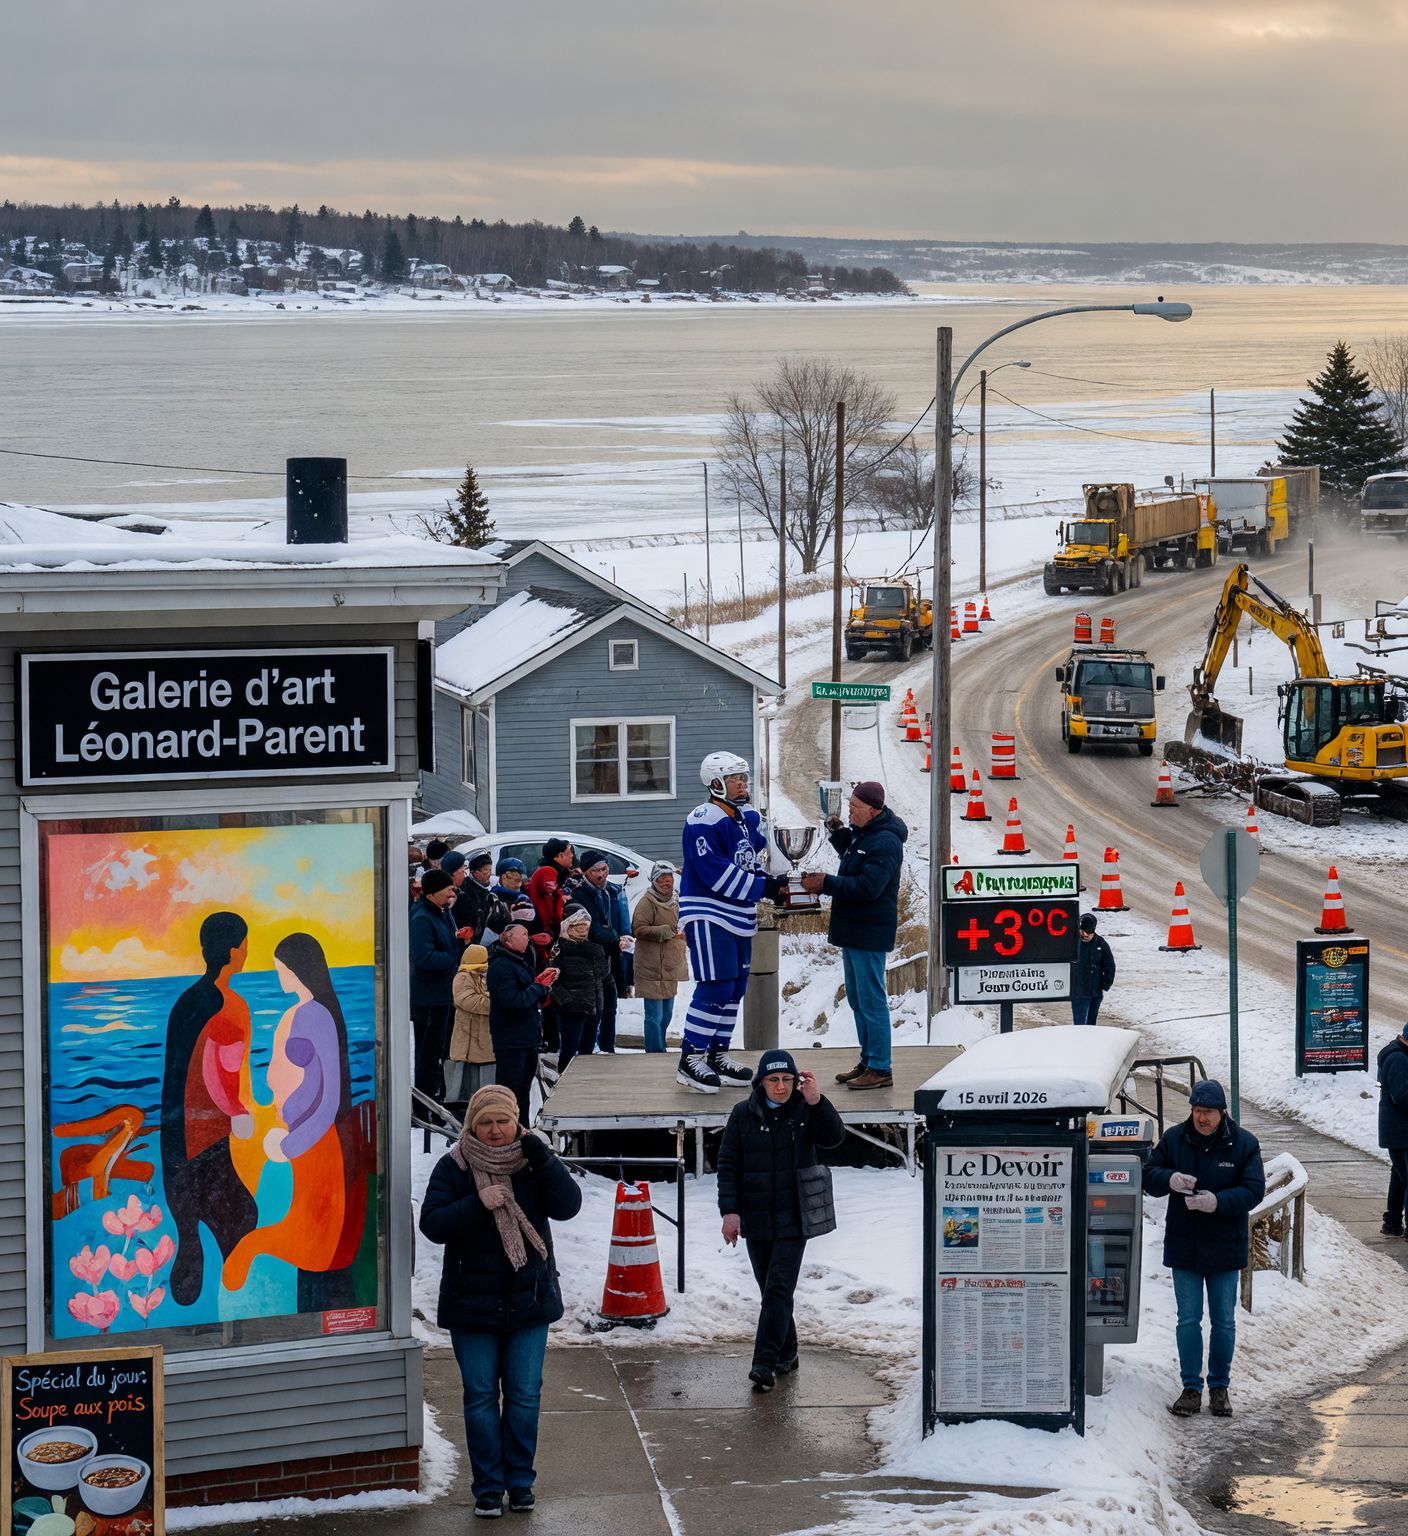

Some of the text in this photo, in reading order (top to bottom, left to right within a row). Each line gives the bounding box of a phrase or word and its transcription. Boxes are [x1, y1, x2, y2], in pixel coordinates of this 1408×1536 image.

[90, 669, 232, 711] Galerie
[55, 717, 366, 763] Léonard-Parent
[957, 908, 1069, 957] +3°C
[958, 1091, 1048, 1105] 15 avril 2026
[944, 1153, 1064, 1178] Le Devoir
[15, 1366, 81, 1398] Spécial
[86, 1365, 106, 1387] du
[16, 1393, 146, 1426] Soupe aux pois
